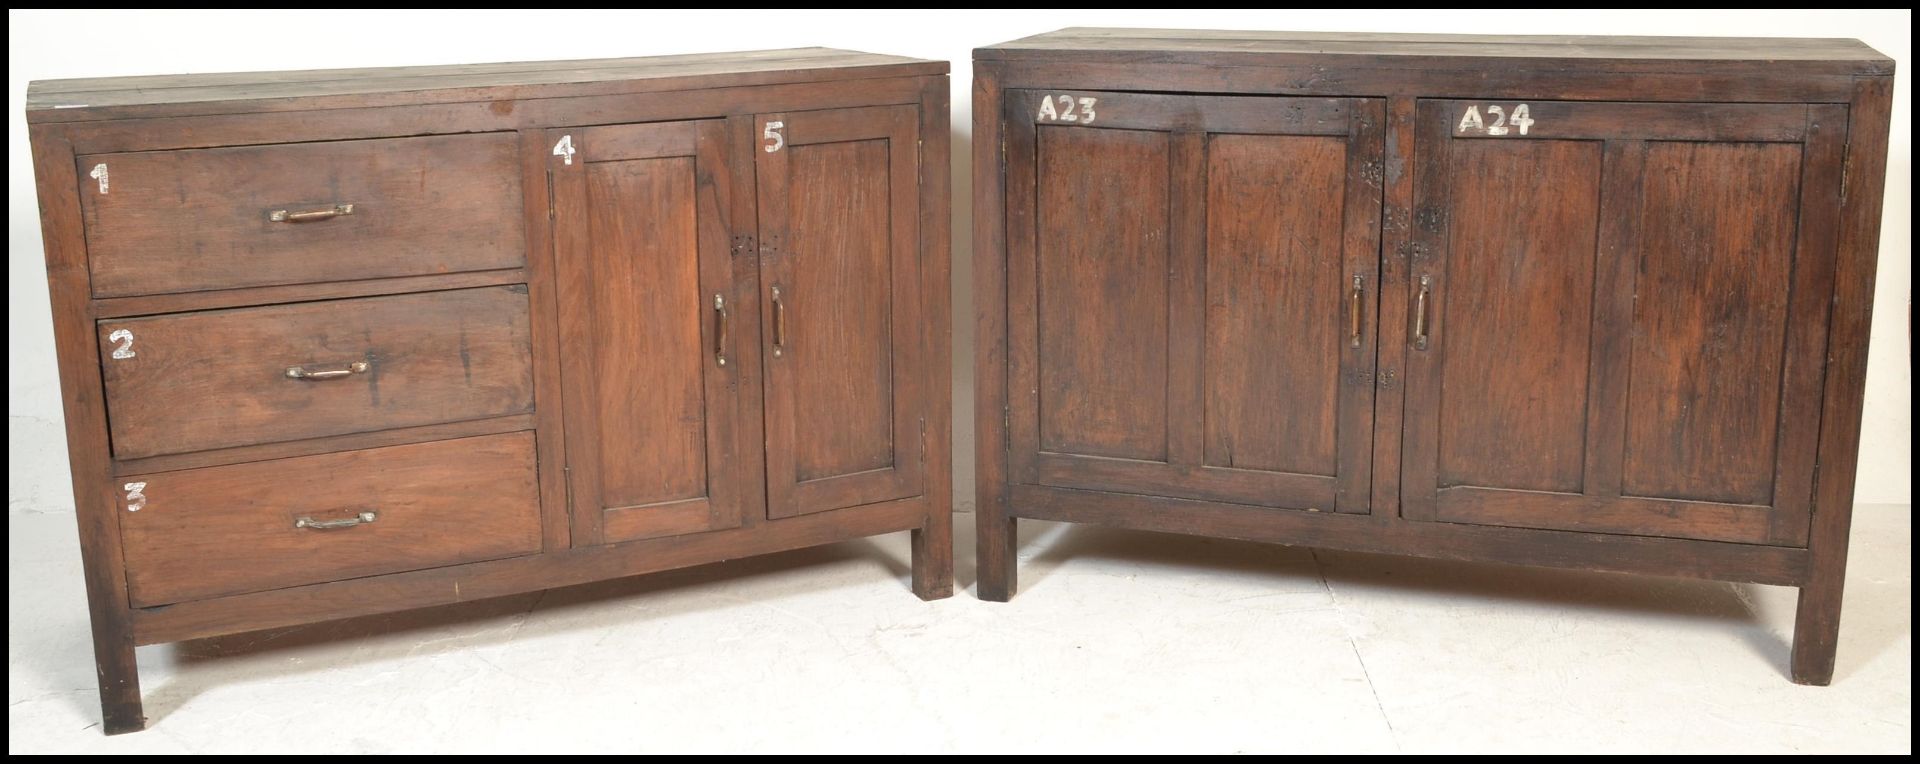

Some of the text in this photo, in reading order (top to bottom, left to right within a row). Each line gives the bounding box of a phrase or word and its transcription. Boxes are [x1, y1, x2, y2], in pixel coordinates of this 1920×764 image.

[1037, 94, 1097, 125] A23
[1458, 103, 1535, 136] A24
[552, 134, 577, 166] 4
[763, 120, 785, 154] 5
[89, 162, 110, 195] 1
[108, 328, 136, 360] 2
[124, 481, 147, 513] 3
